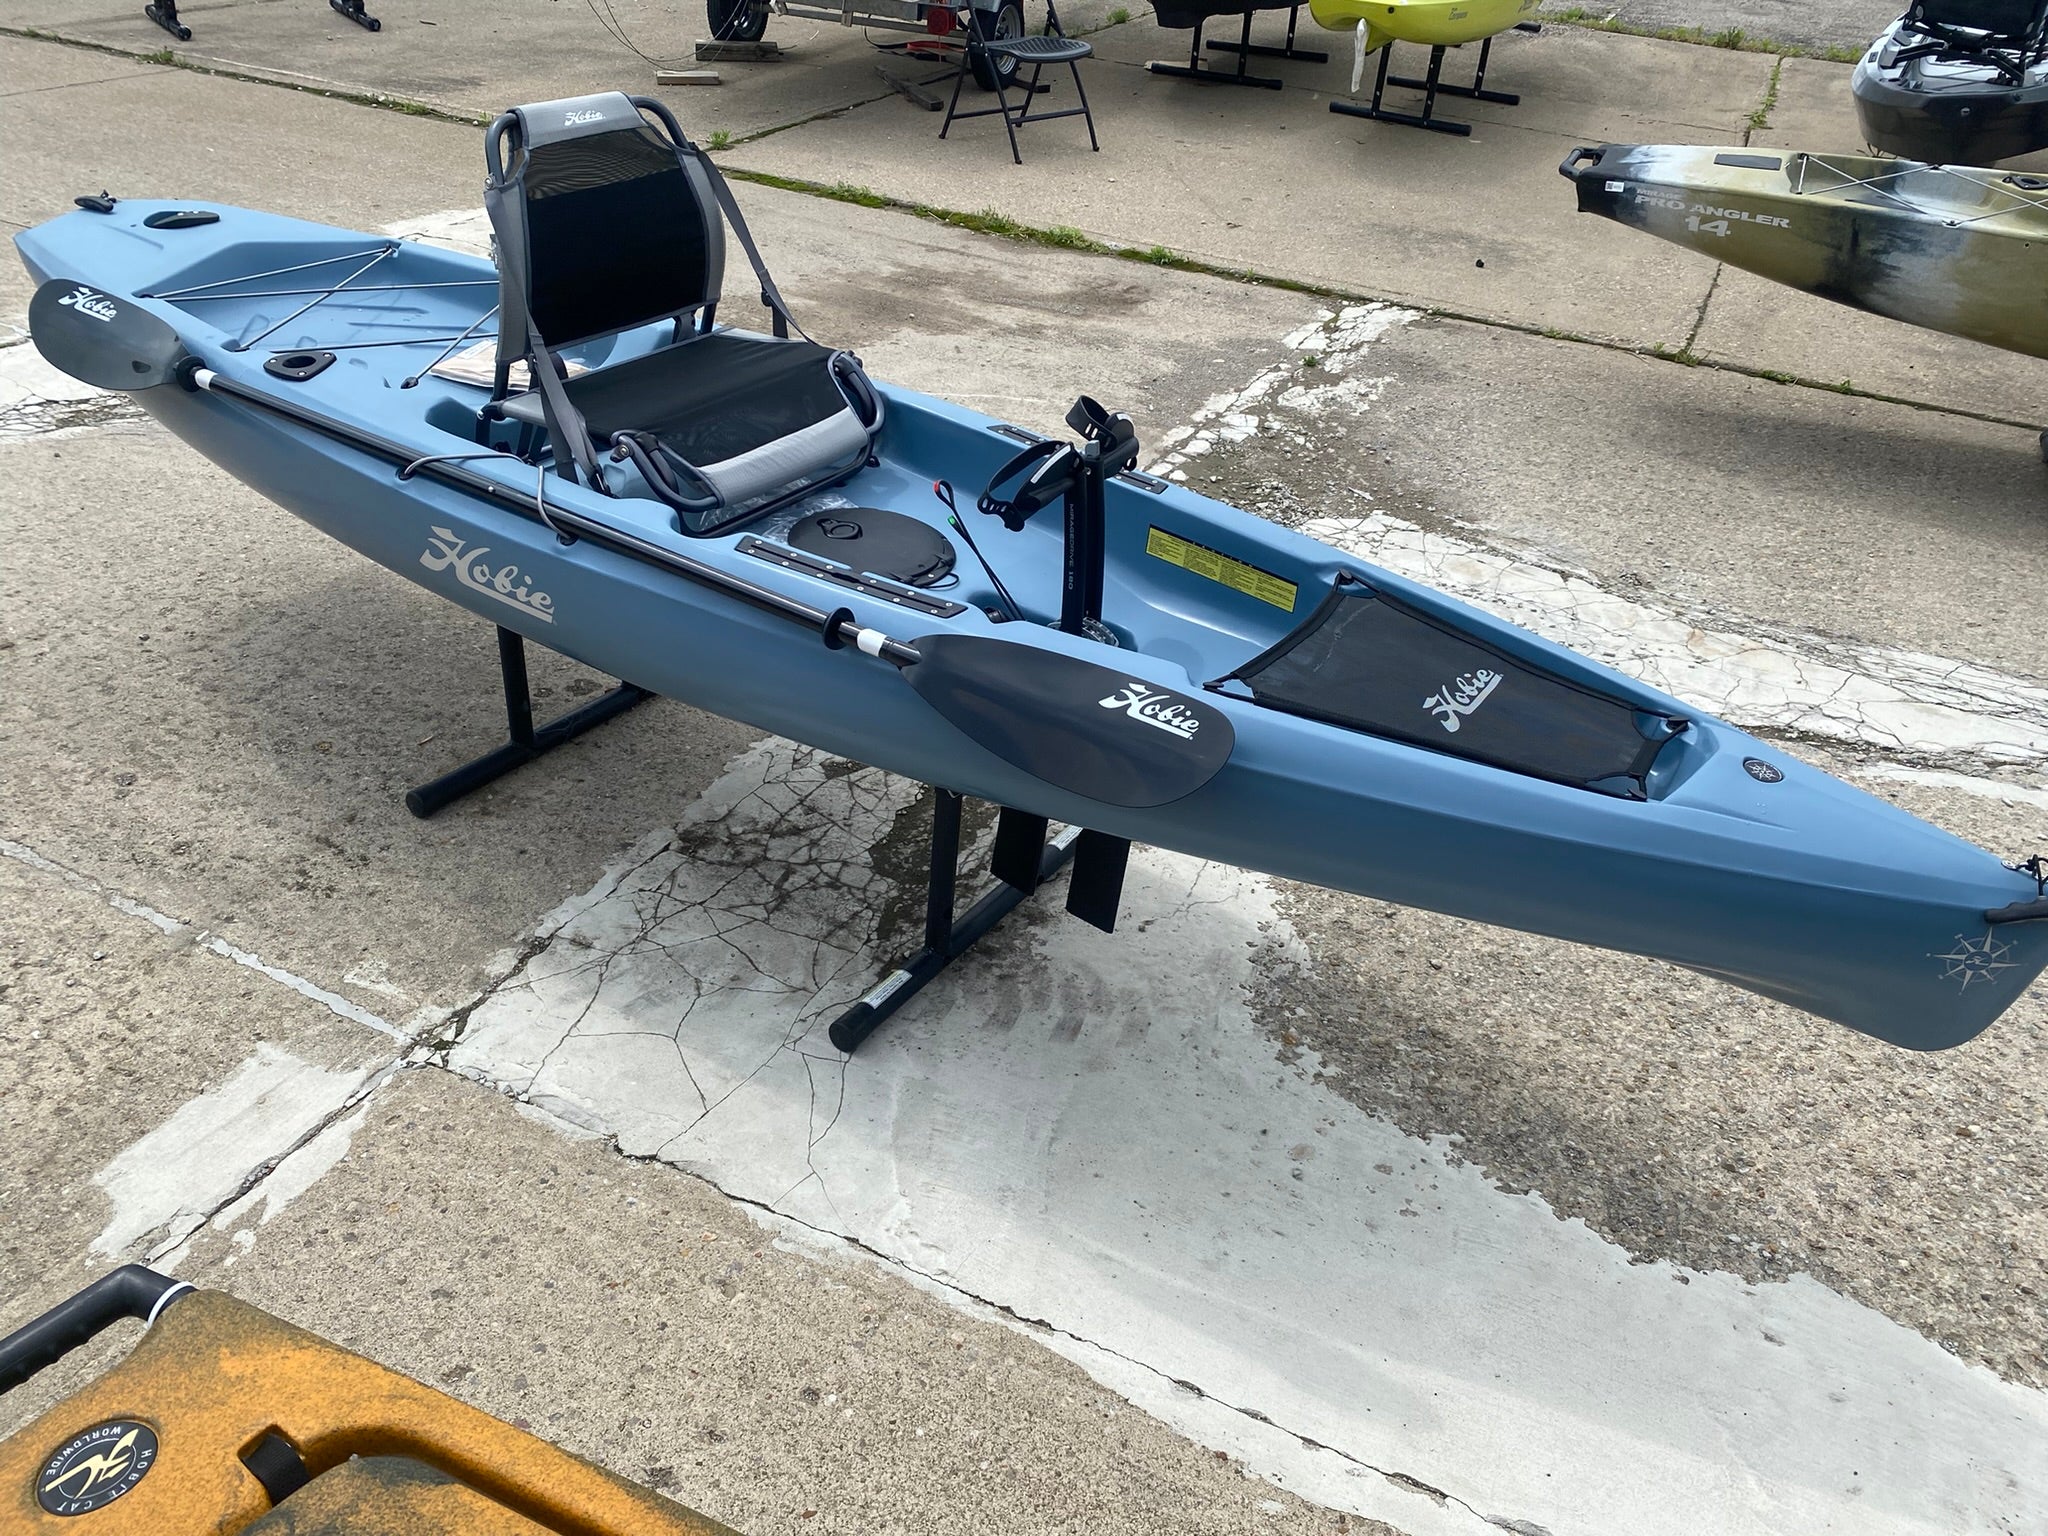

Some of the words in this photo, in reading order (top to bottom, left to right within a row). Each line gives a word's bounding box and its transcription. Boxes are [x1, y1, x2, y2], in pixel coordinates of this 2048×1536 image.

[564, 110, 604, 126] Hobie
[1636, 188, 1682, 199] MIRAGE
[1635, 195, 1685, 210] PRO
[1689, 204, 1790, 228] ANGLER
[1685, 215, 1729, 237] 14
[58, 286, 117, 322] Hobie
[419, 525, 555, 624] Hobie
[1098, 682, 1200, 739] Hobie
[1422, 669, 1503, 733] Hobie
[46, 1426, 121, 1476] WORLDWIDE
[57, 1501, 92, 1512] CAT
